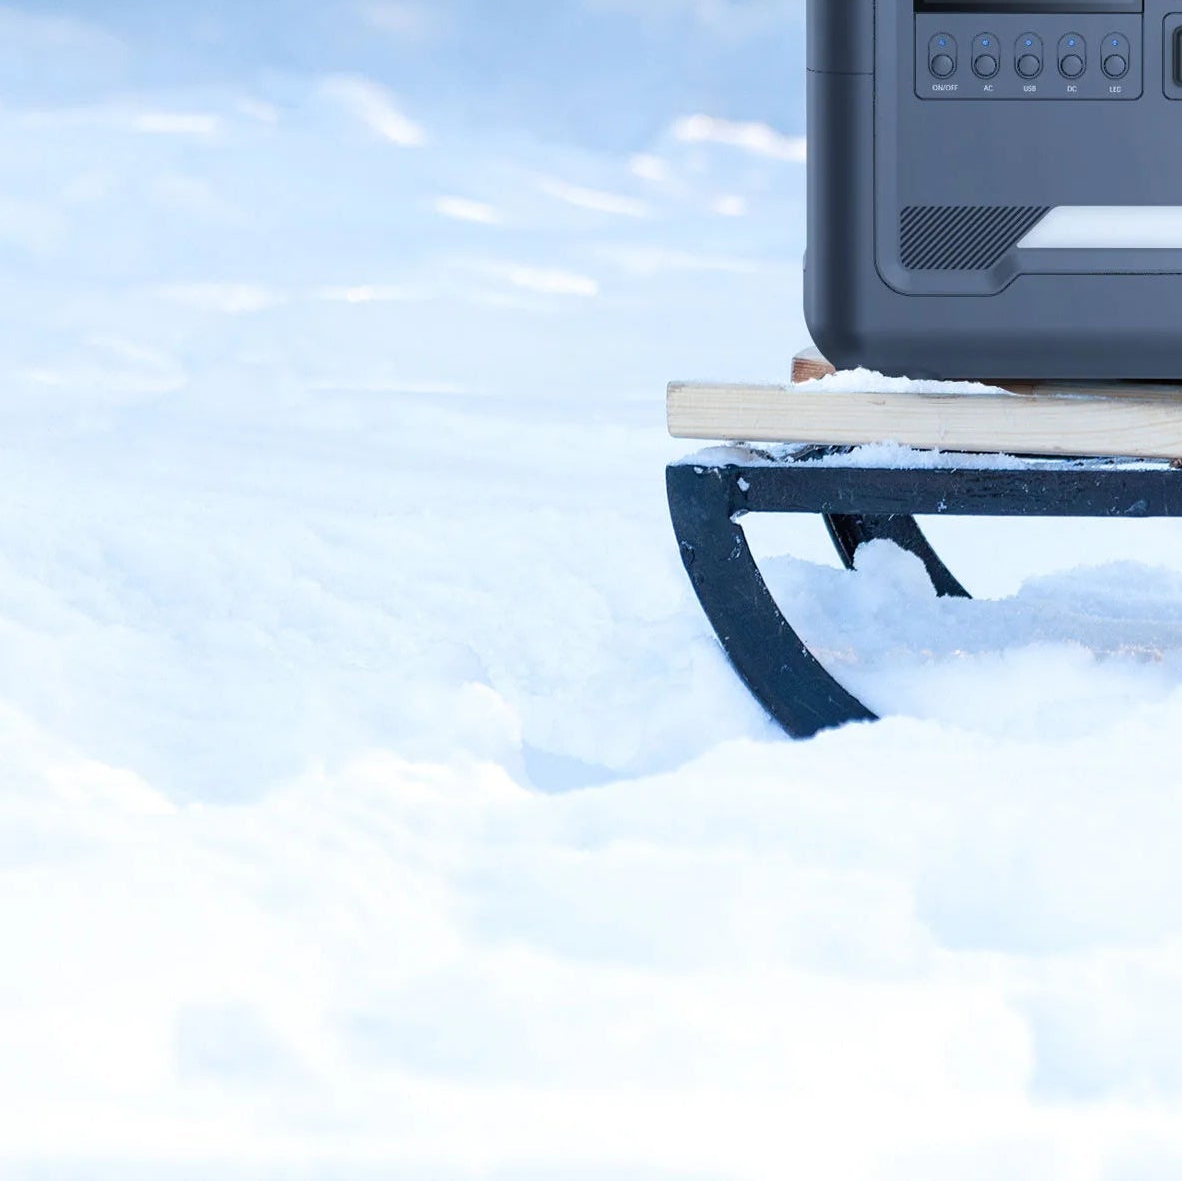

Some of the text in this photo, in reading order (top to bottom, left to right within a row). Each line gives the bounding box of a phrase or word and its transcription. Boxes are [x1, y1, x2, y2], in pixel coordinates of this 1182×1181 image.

[932, 84, 959, 92] ON/OFF
[983, 84, 994, 92] AC
[1109, 85, 1122, 93] LED
